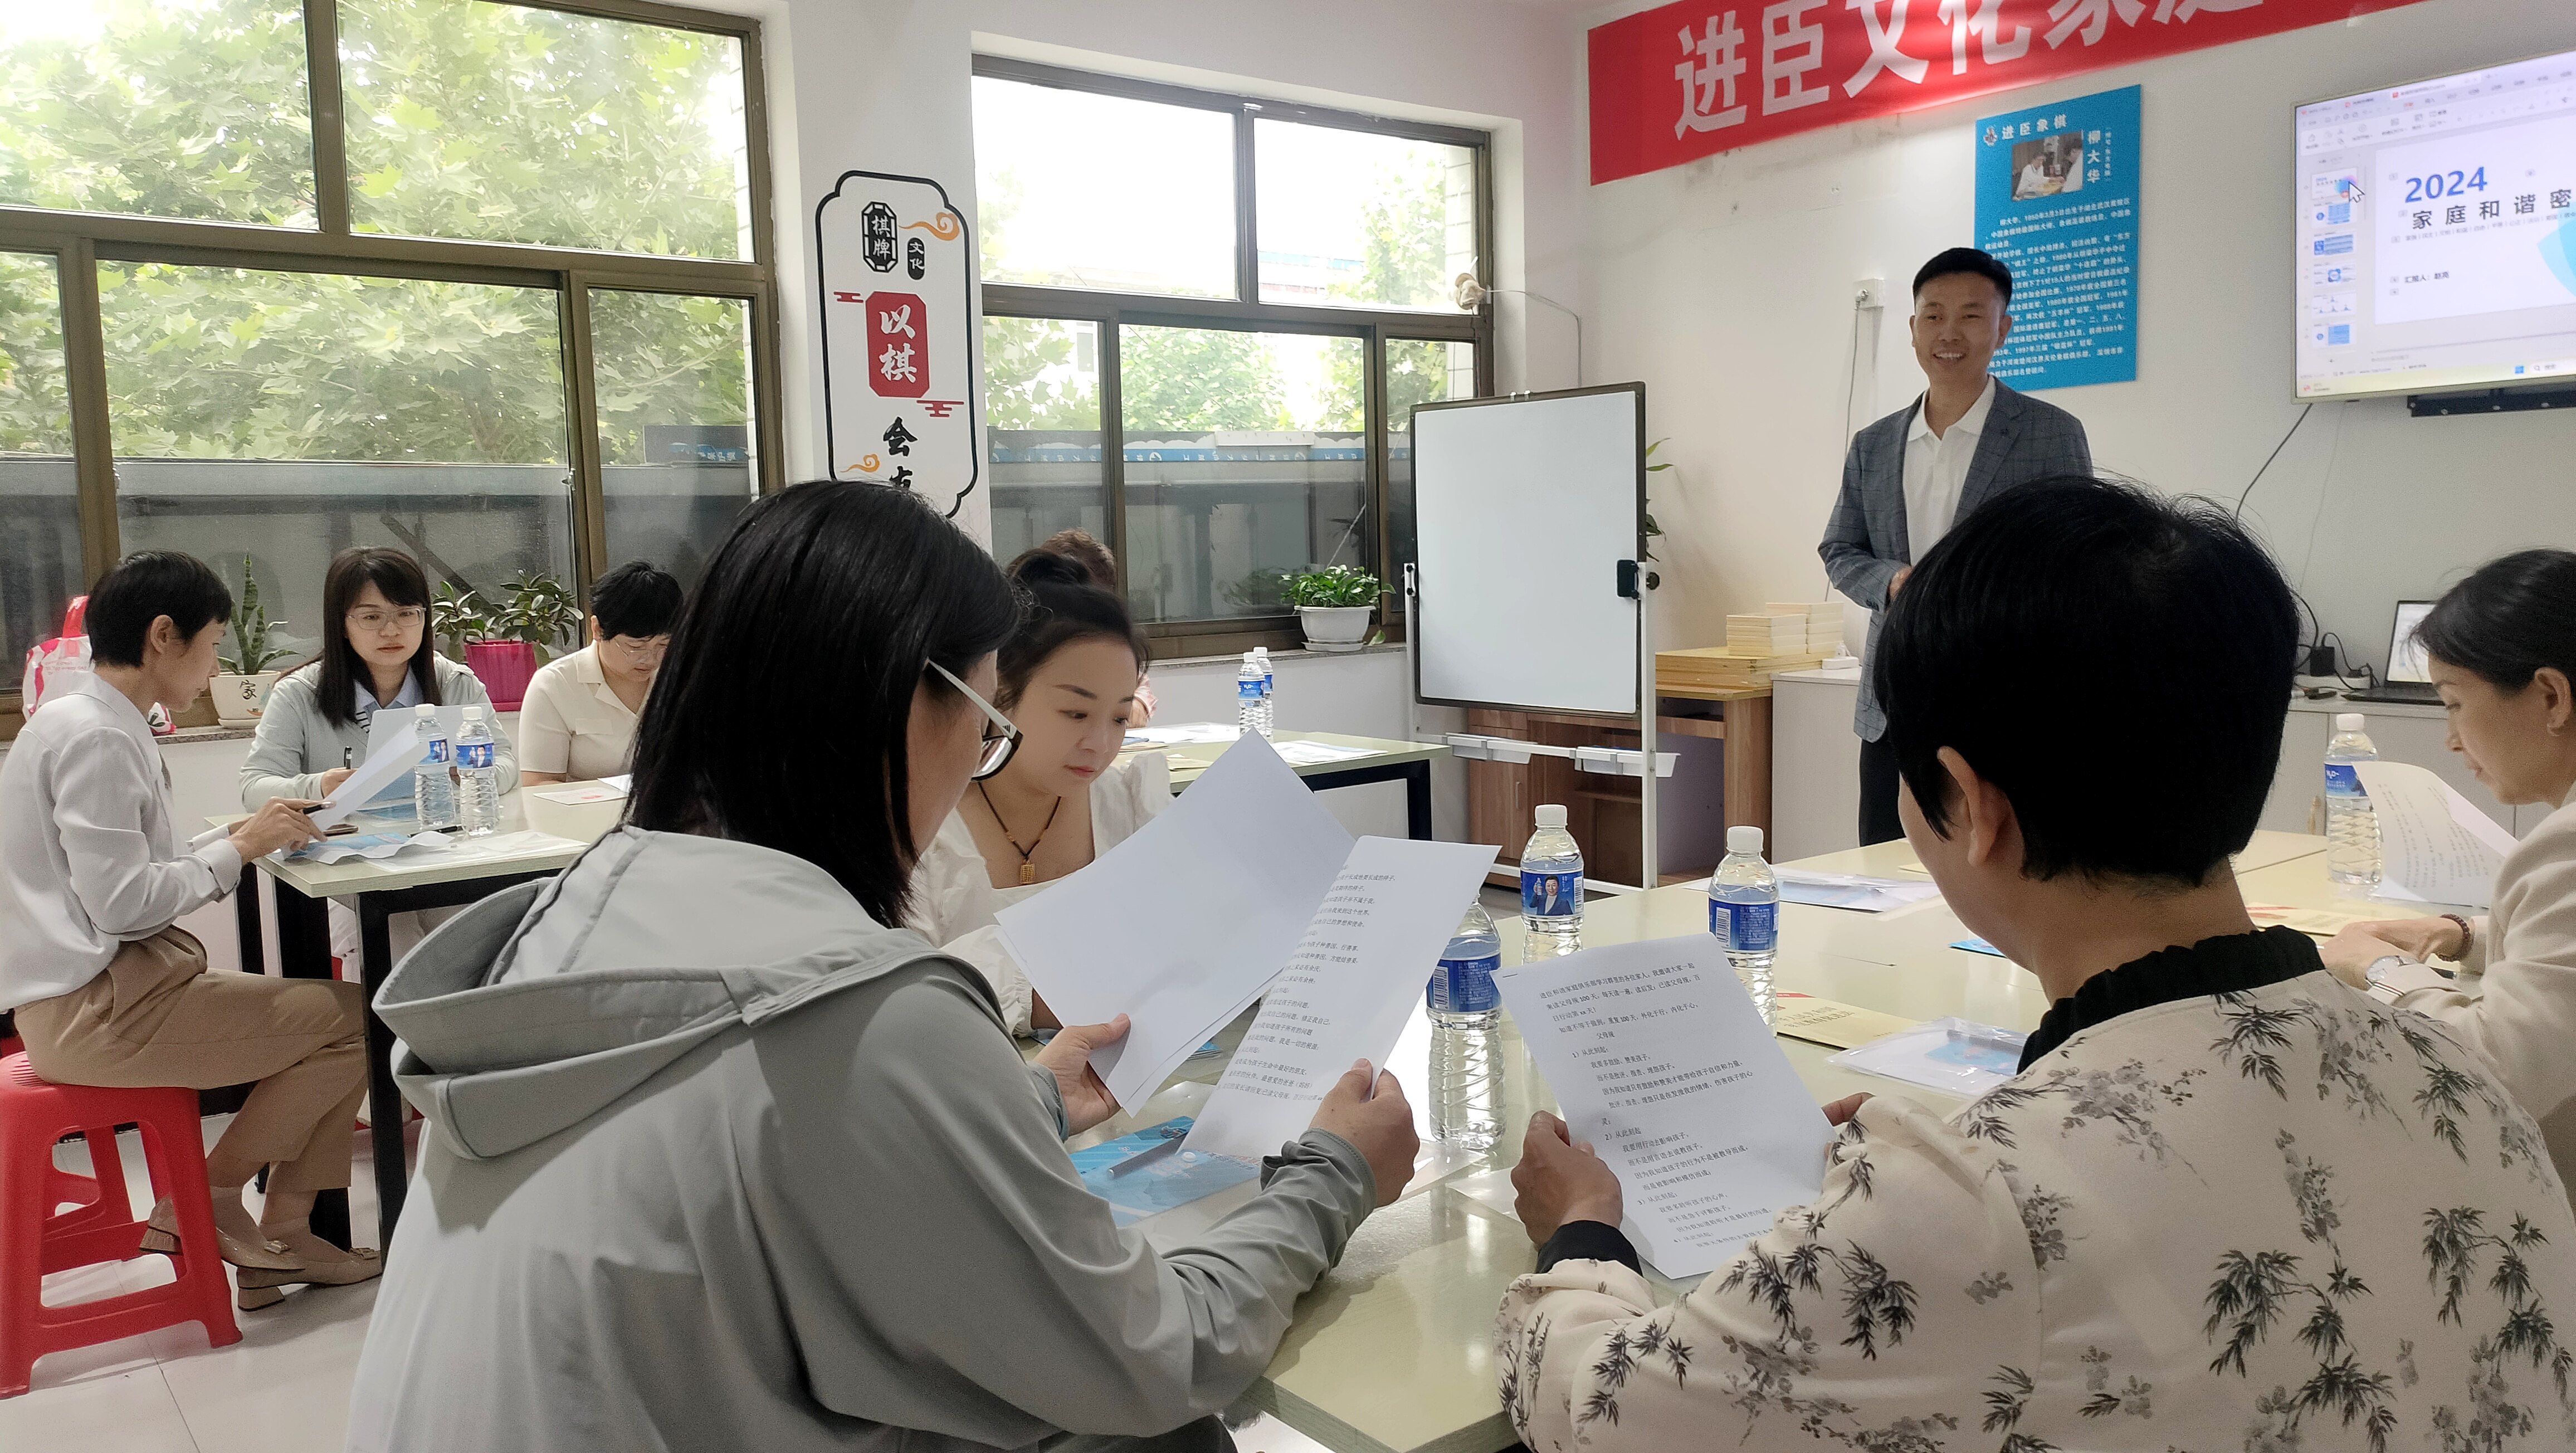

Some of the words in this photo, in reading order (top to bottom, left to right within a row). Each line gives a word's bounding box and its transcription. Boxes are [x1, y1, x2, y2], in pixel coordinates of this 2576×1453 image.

[1675, 0, 2263, 140] 进臣文化
[2002, 114, 2067, 140] 进臣象棋
[2087, 130, 2101, 183] 柳大华
[2404, 167, 2488, 203] 2024
[2412, 188, 2572, 230] 家庭和谐密
[871, 215, 891, 260] 棋牌
[908, 241, 925, 270] 文化
[879, 304, 918, 383] 以棋
[240, 680, 257, 700] 家
